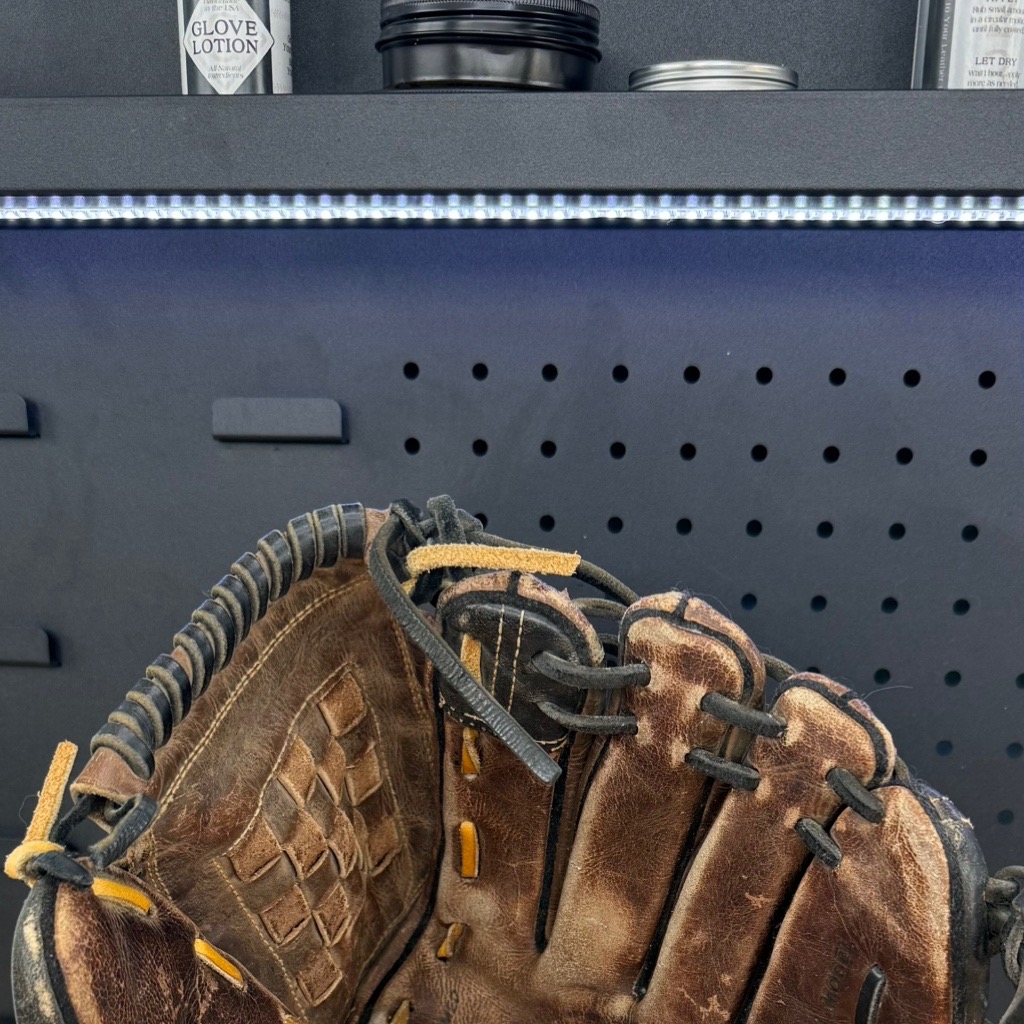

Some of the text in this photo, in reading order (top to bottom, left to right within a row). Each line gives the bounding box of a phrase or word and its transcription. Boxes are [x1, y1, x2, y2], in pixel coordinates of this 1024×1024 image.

[191, 19, 259, 37] GLOVE
[192, 38, 259, 56] LOTION
[975, 57, 1018, 66] LET DRY
